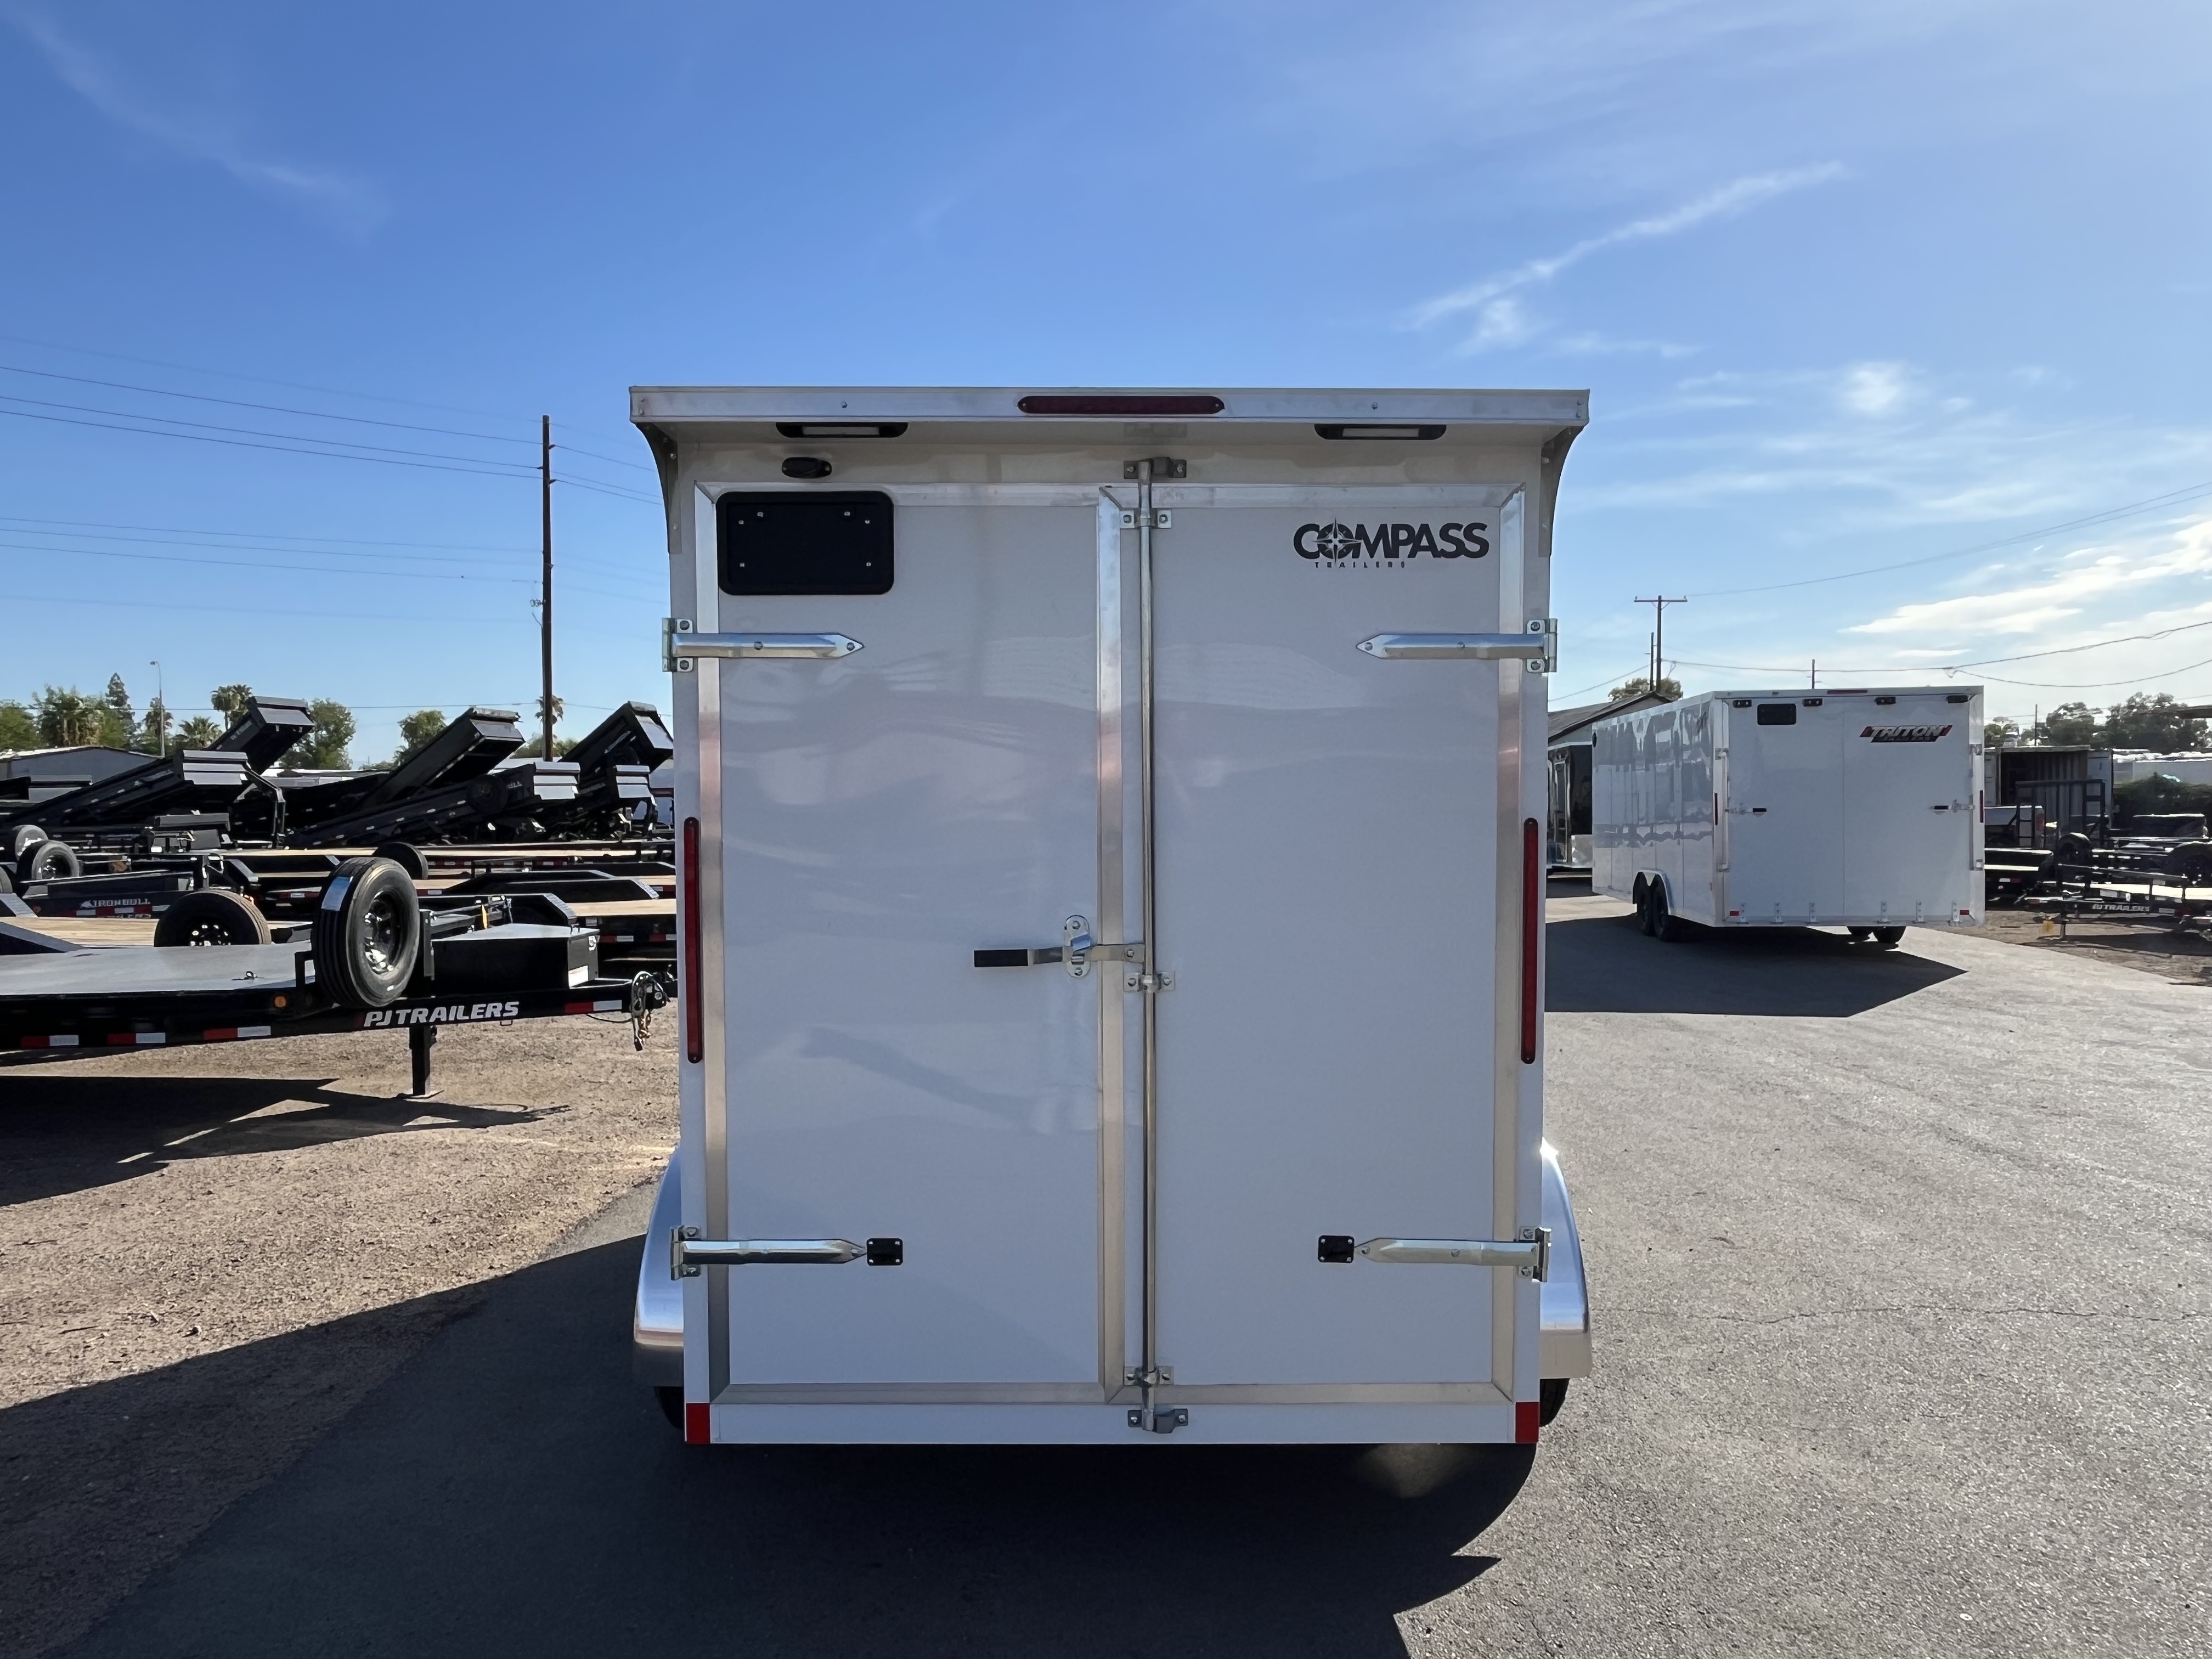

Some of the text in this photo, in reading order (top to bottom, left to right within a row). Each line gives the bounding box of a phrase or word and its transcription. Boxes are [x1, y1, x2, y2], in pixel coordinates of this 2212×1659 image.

[1294, 522, 1489, 559] COMPASS
[1870, 725, 1944, 737] TRITON
[364, 1001, 519, 1027] PJ TRAILERS
